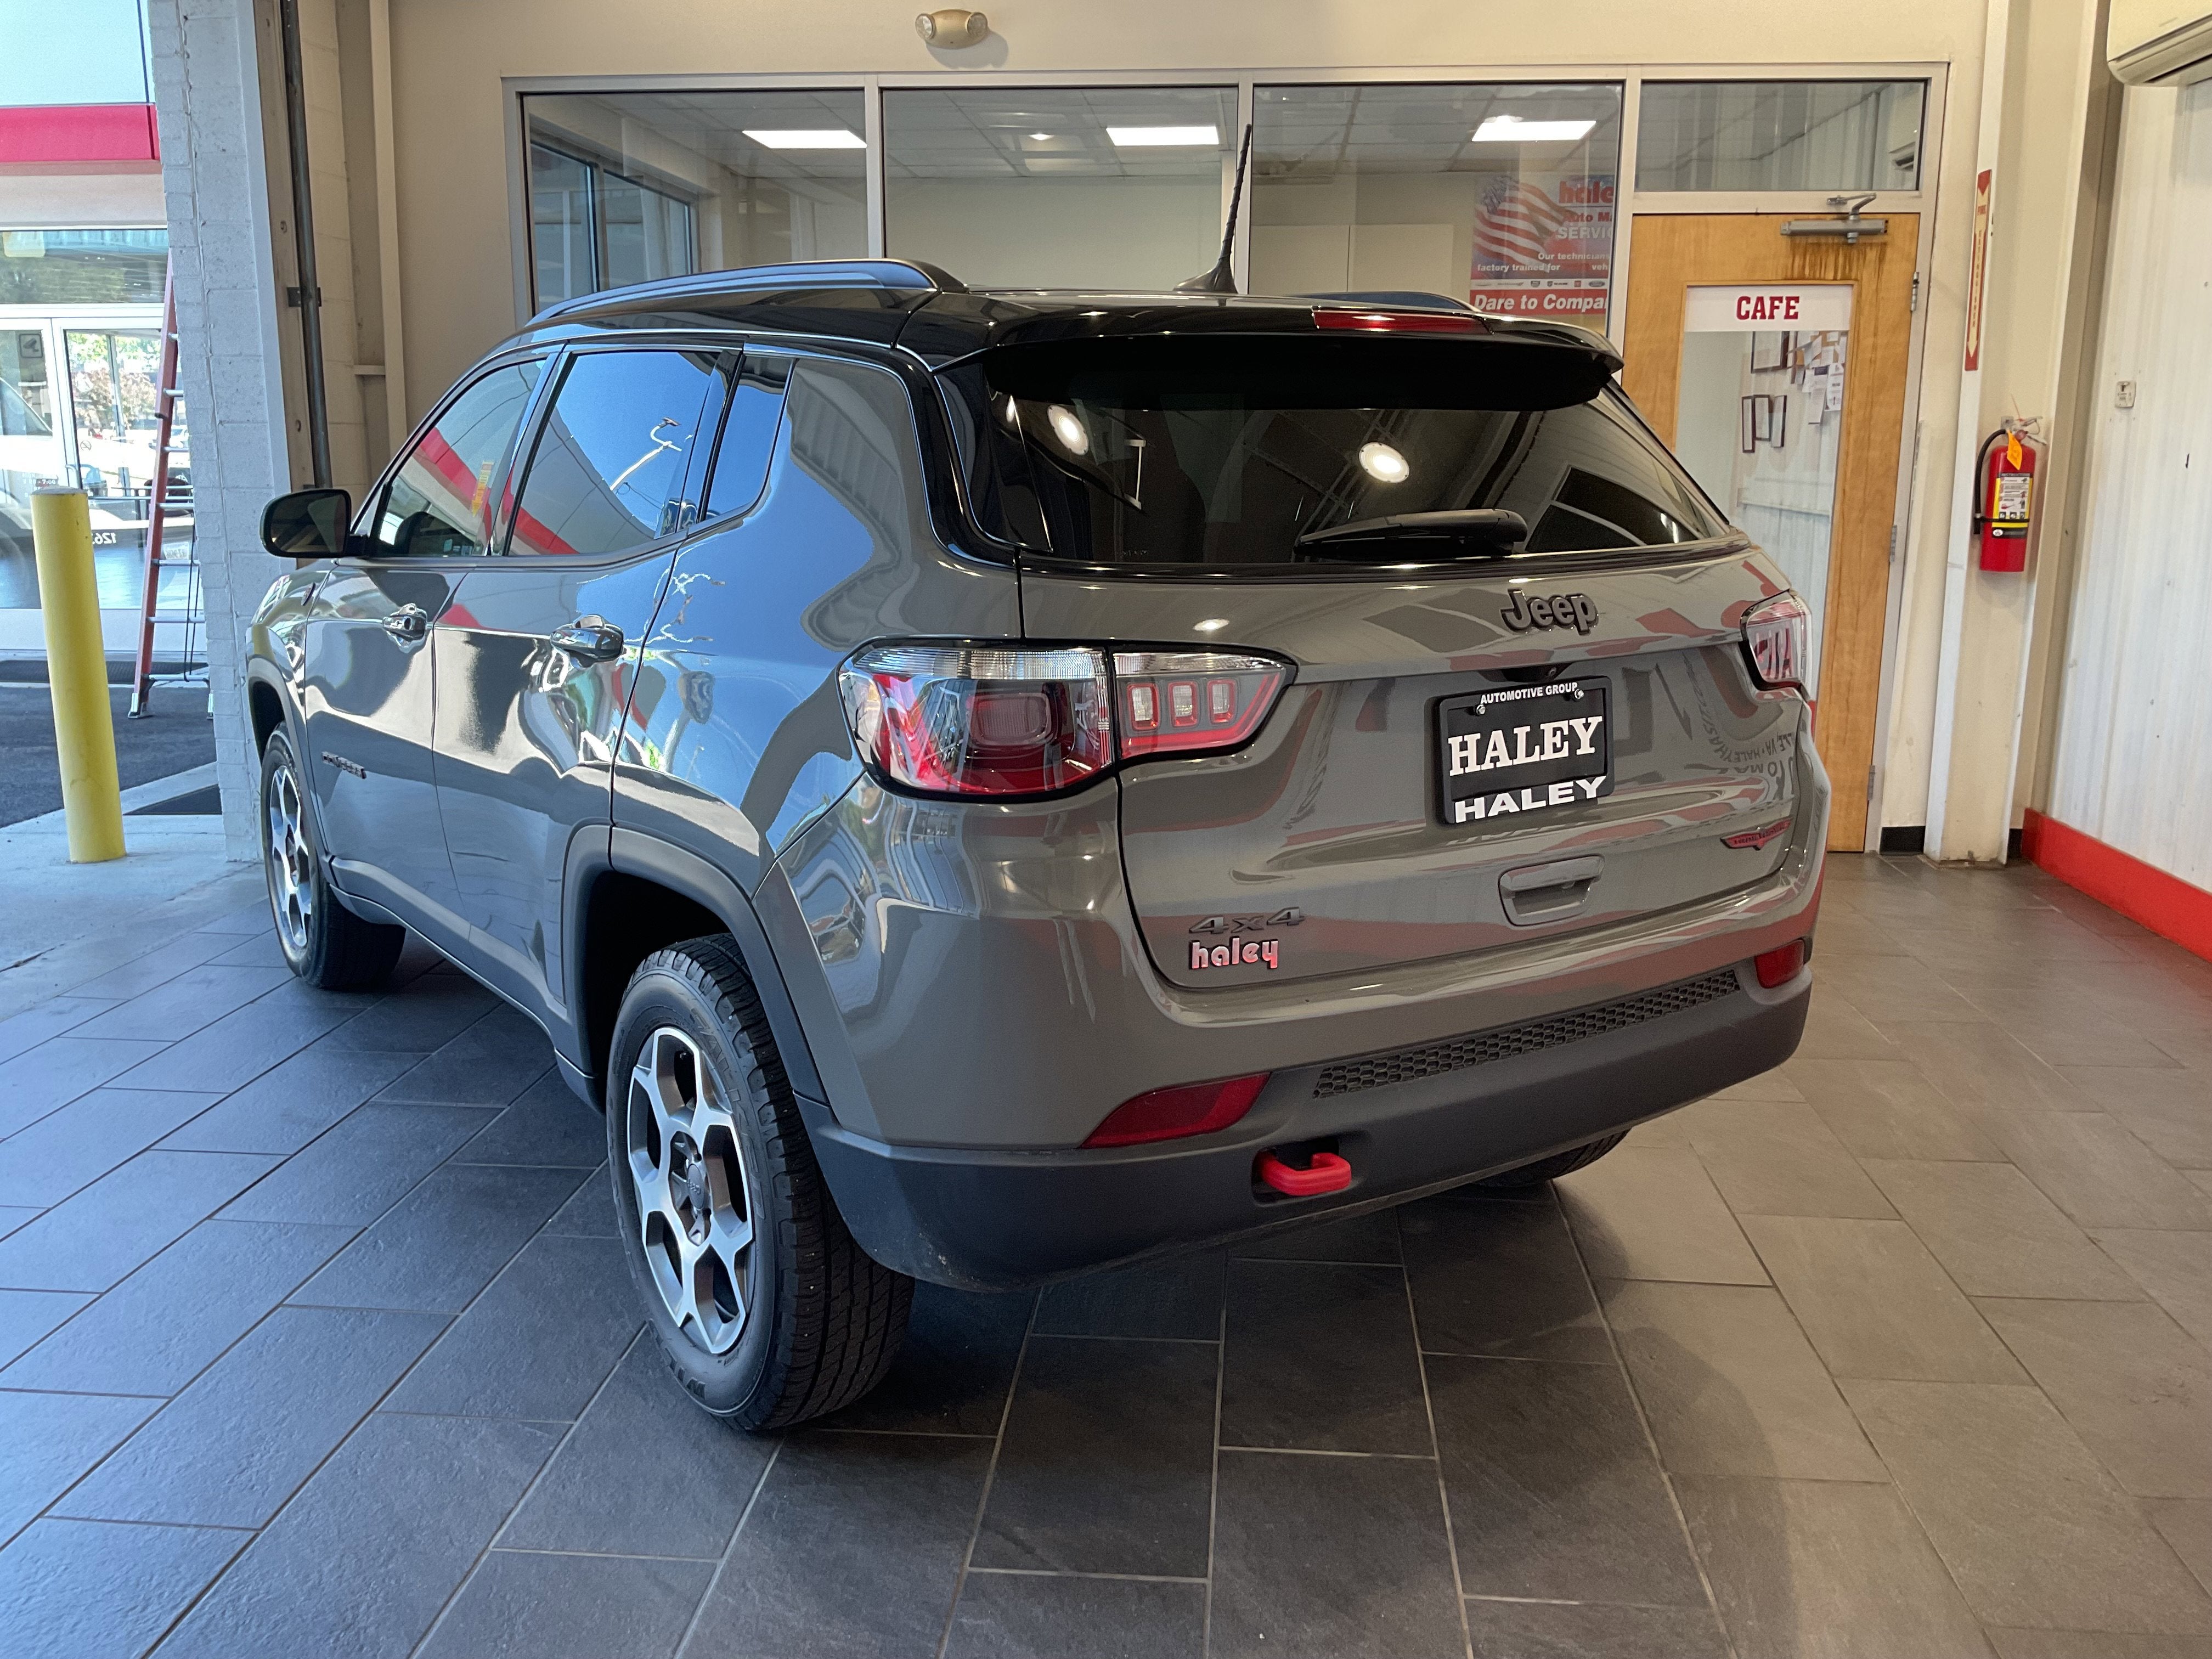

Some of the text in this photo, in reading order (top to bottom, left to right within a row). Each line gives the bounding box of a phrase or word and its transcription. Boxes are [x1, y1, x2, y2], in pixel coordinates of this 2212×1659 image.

[1598, 212, 1612, 222] M
[1477, 264, 1509, 273] factory
[1474, 294, 1515, 311] Dare
[1520, 295, 1538, 309] to
[1736, 296, 1800, 320] CAFE
[1500, 588, 1599, 636] Jeep
[1480, 682, 1578, 704] AUTOMOTIVE GROUP
[1448, 716, 1602, 776] HALEY
[1455, 776, 1606, 823] HALEY
[1189, 906, 1305, 934] 4x4
[1189, 936, 1278, 970] haley
